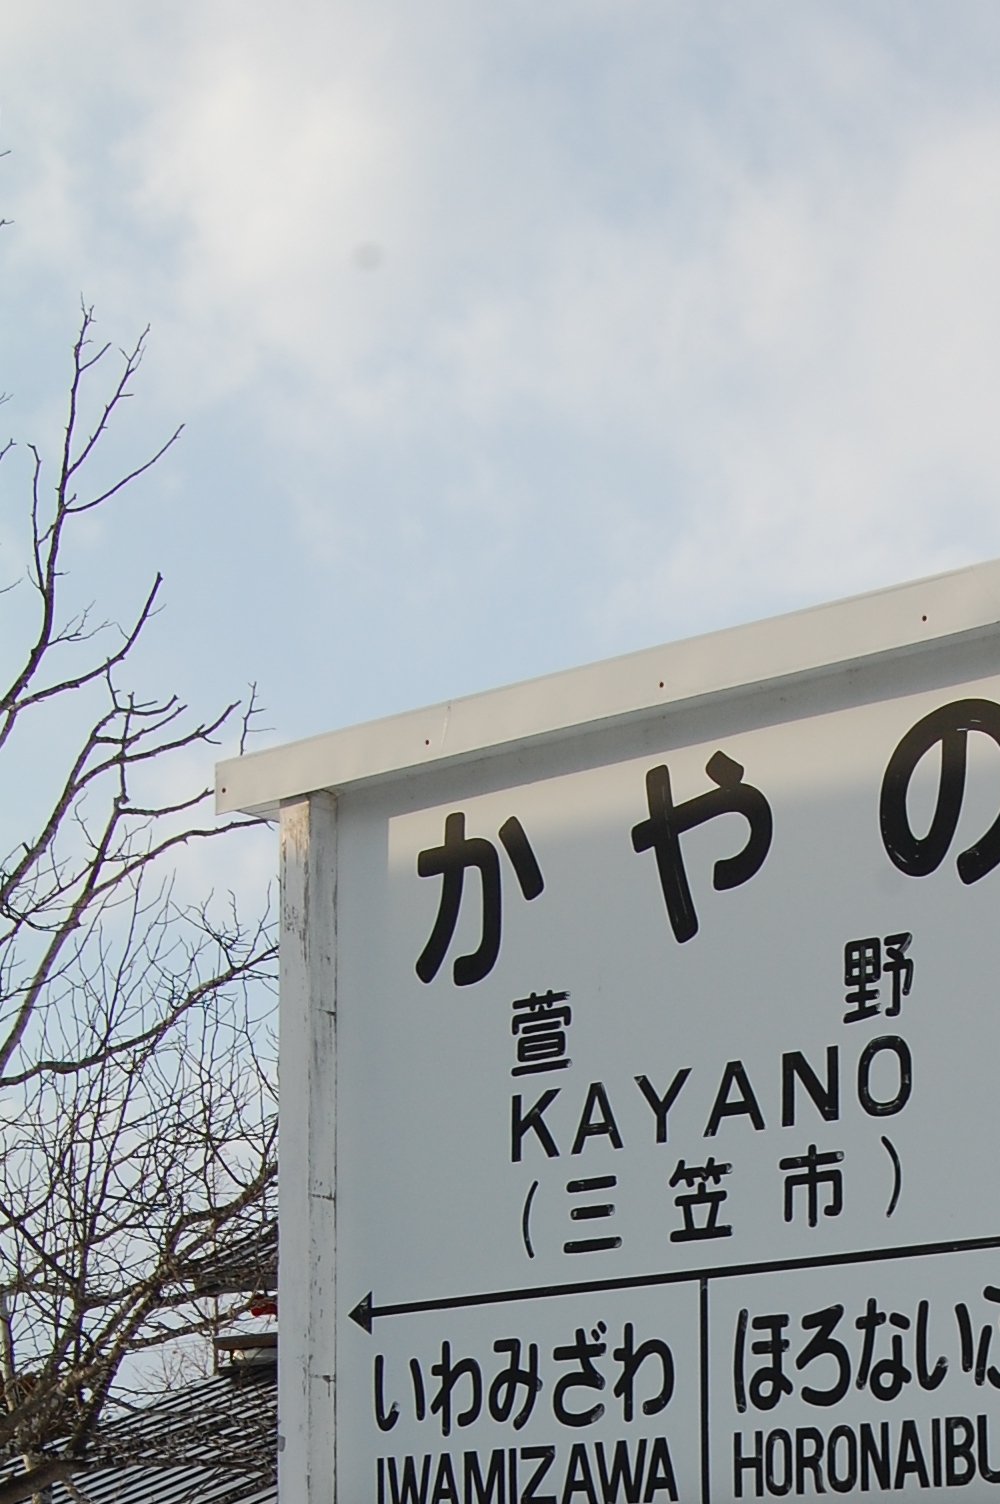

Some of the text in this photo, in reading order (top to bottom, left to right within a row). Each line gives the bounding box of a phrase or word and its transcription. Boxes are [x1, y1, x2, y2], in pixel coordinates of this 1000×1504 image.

[510, 931, 915, 1078] 萱野
[510, 1034, 913, 1163] KAYANO
[522, 1135, 903, 1259] (三笠市)
[374, 1319, 676, 1437] いわみざわ
